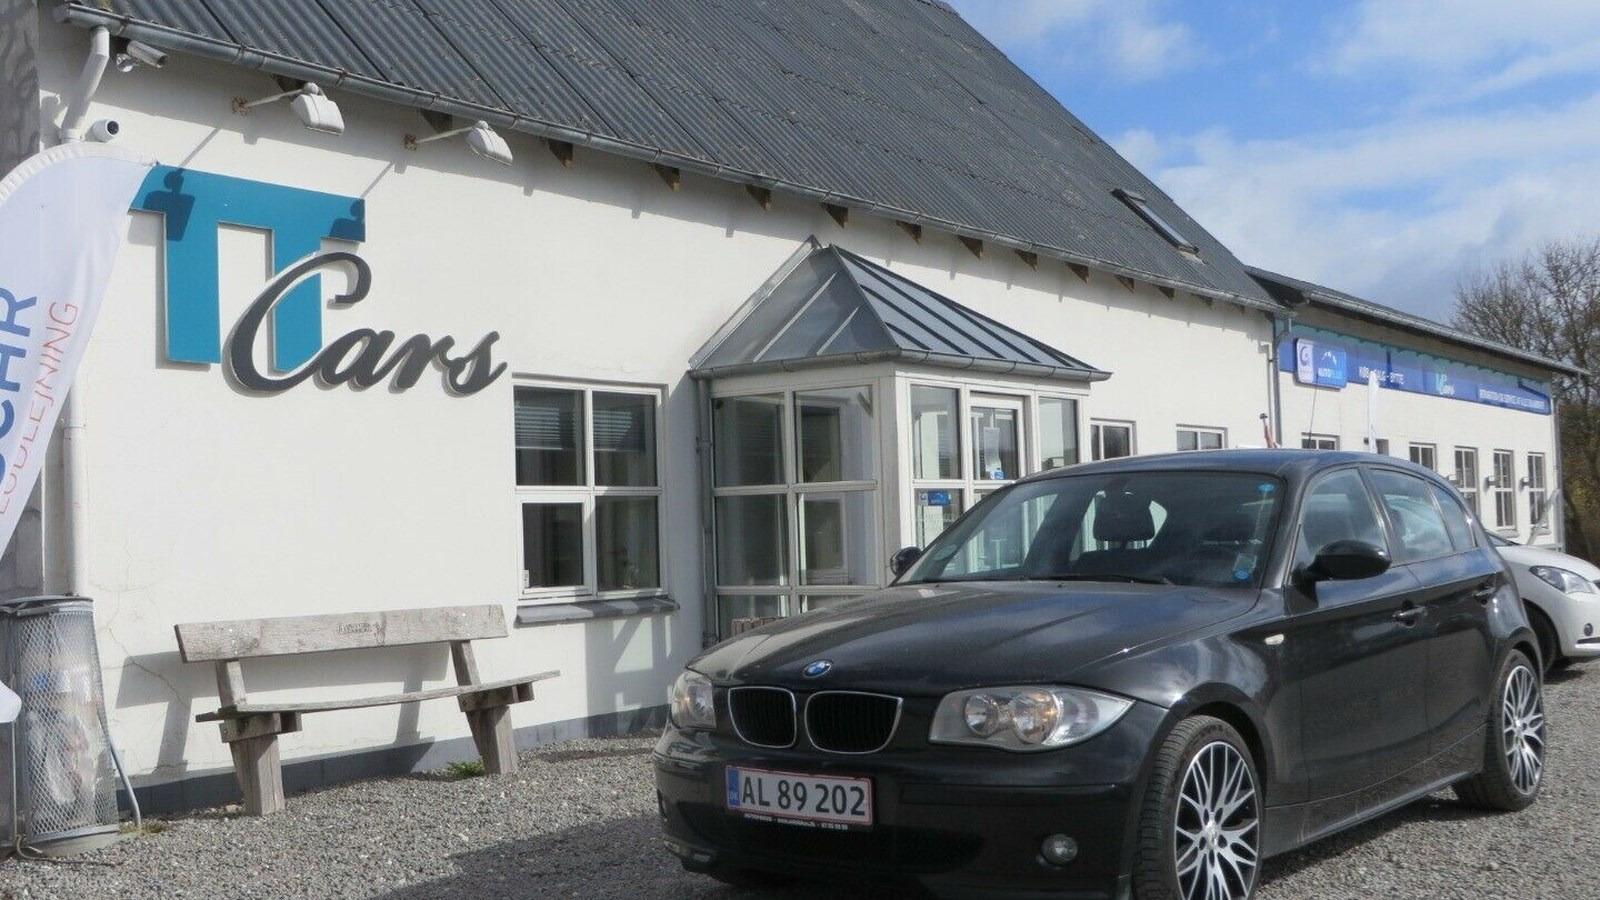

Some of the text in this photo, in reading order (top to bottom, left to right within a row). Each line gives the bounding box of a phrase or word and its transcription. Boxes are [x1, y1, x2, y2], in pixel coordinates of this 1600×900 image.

[129, 164, 366, 371] TT
[230, 251, 508, 394] Cars
[742, 776, 866, 816] AL 89 202
